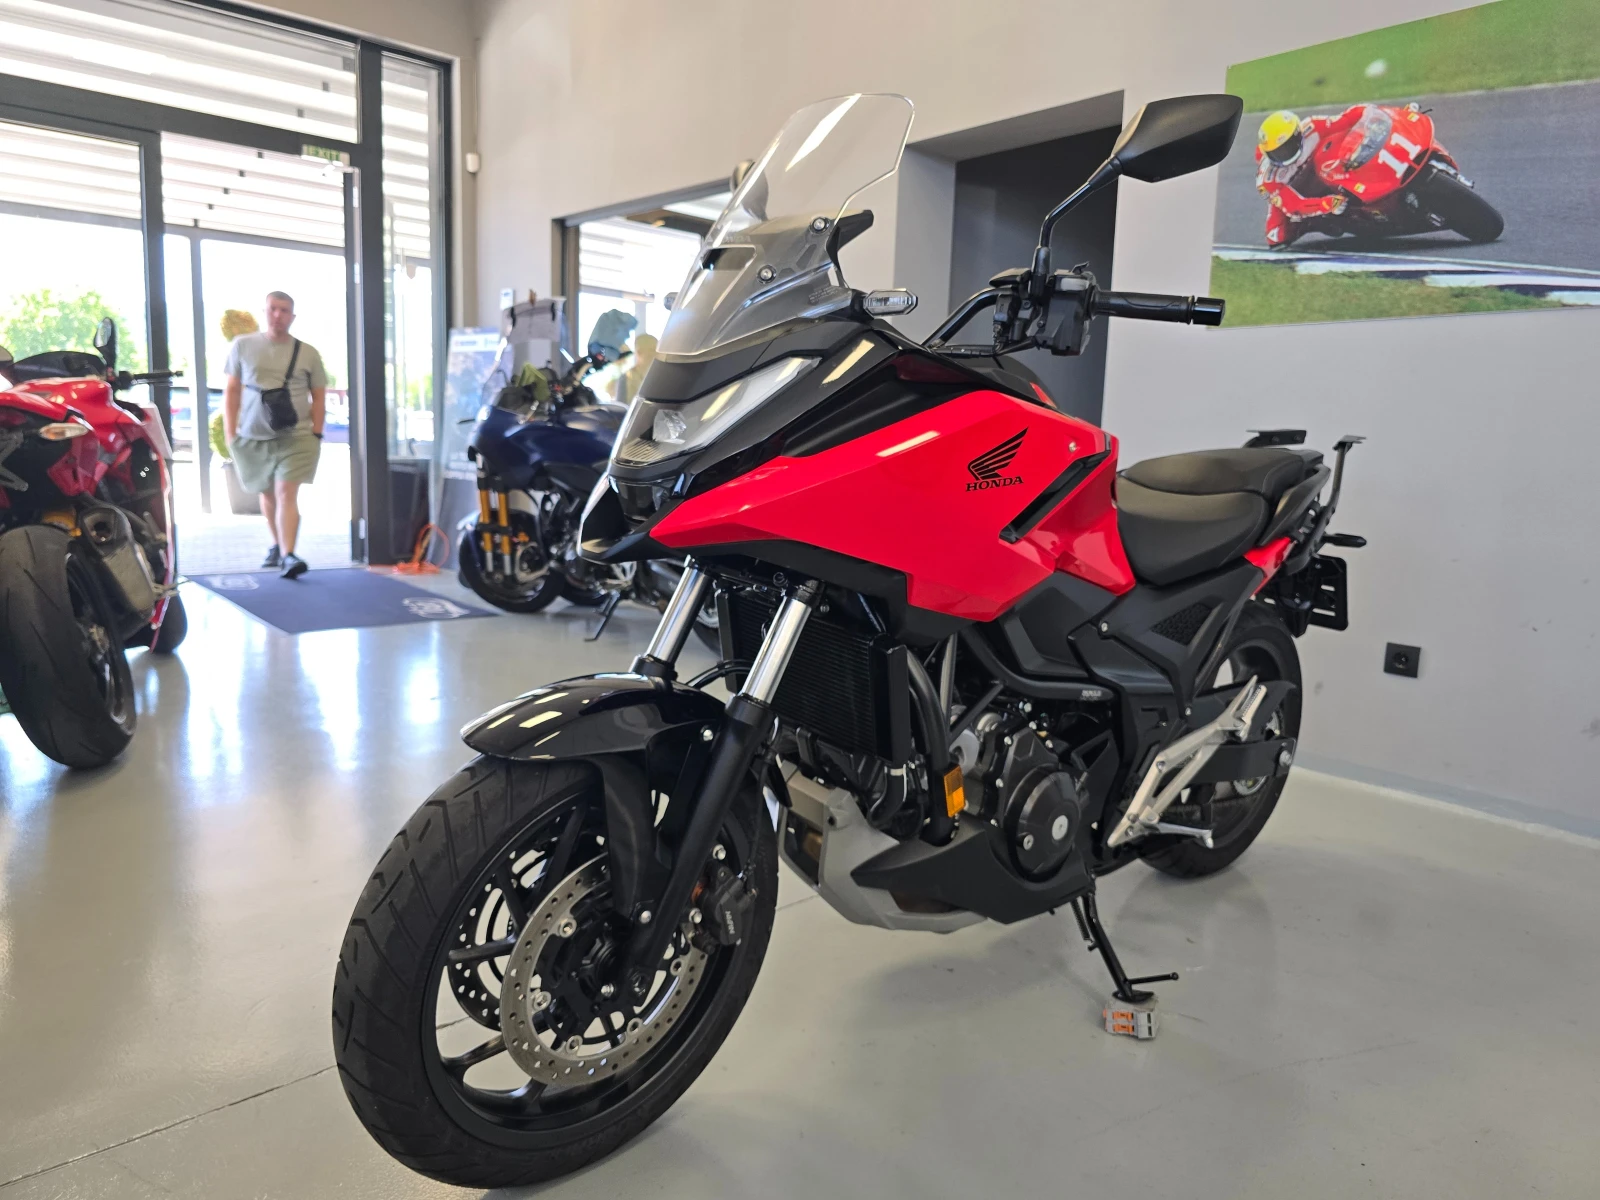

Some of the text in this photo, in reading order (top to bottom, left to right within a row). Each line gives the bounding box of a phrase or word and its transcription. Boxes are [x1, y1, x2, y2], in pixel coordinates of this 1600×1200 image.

[308, 145, 340, 161] EXIT
[1378, 132, 1421, 178] 11
[966, 476, 1024, 492] HONDA
